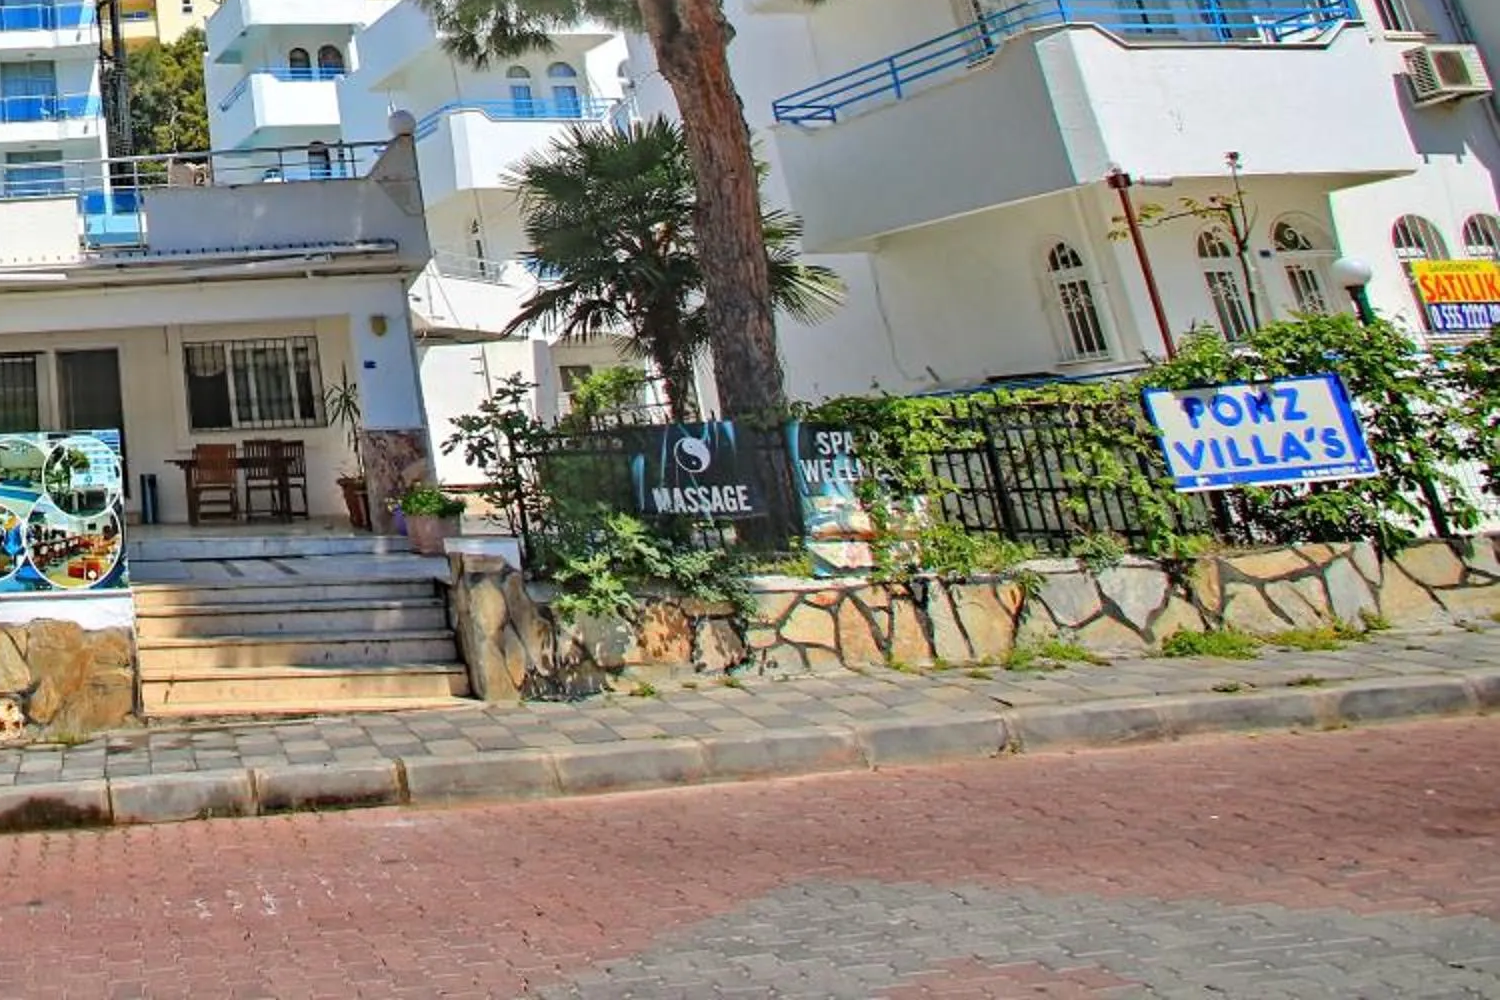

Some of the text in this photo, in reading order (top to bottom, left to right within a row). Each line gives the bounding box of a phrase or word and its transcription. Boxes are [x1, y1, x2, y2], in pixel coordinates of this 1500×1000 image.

[1181, 387, 1308, 429] PONZ
[816, 431, 857, 455] SPA
[1173, 427, 1346, 470] VILLA'S
[652, 484, 752, 513] MASSAGE
